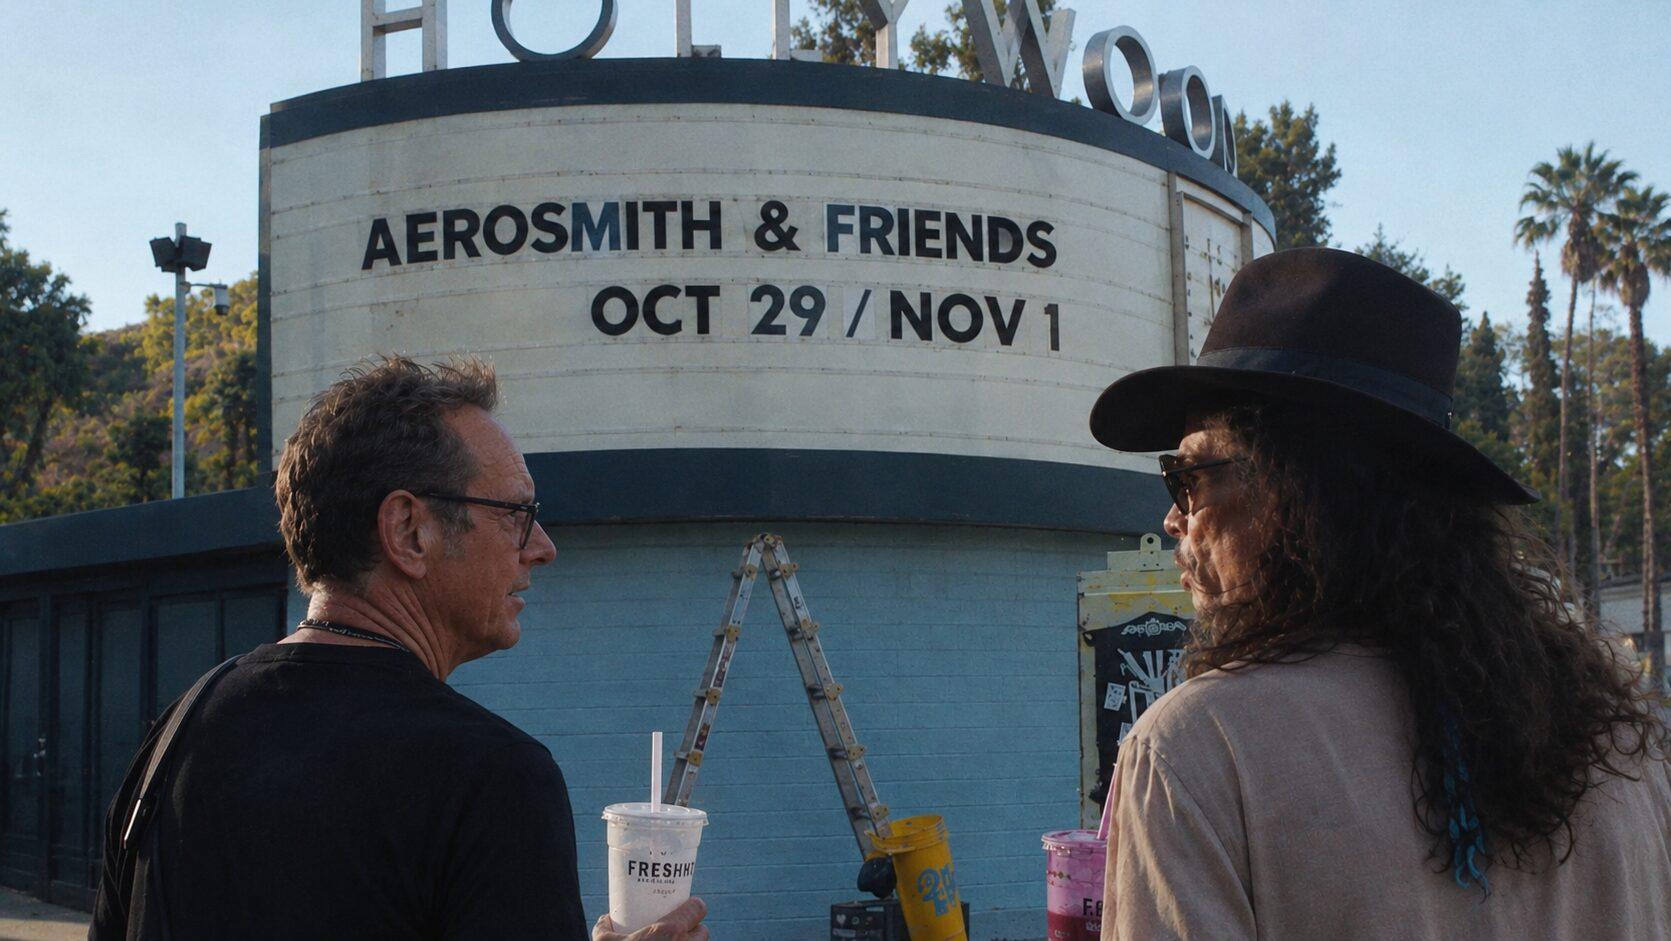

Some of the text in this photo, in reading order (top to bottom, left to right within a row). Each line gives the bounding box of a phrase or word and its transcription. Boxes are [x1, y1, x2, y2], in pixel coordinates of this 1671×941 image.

[361, 200, 1057, 270] AEROSMITH & FRIENDS
[591, 284, 1060, 351] OCT 29 / NOV 1
